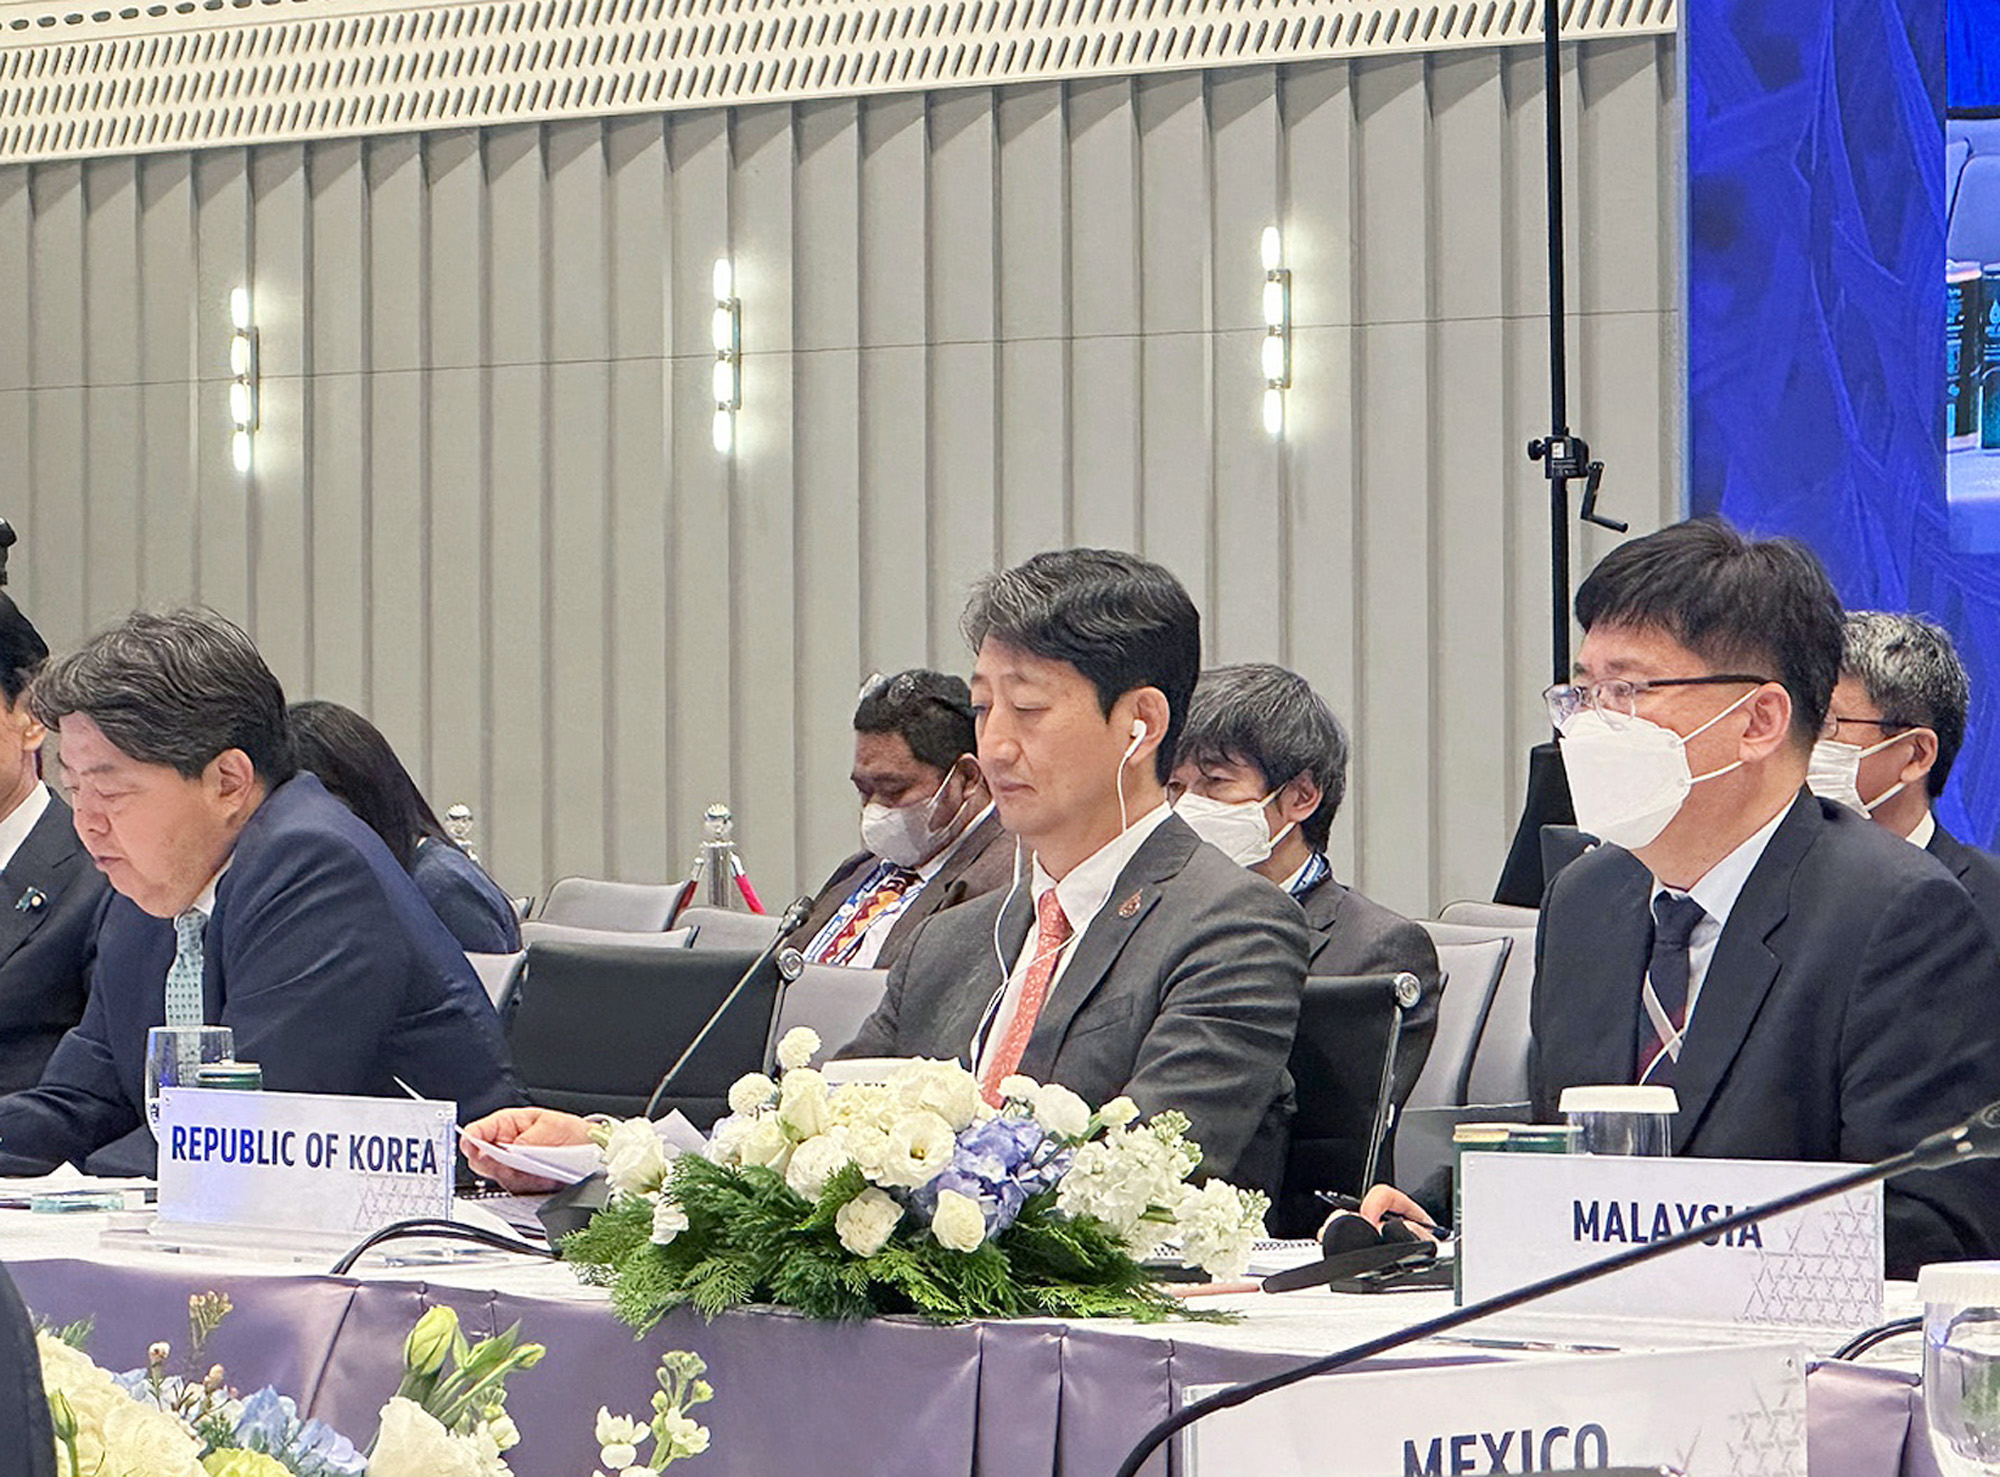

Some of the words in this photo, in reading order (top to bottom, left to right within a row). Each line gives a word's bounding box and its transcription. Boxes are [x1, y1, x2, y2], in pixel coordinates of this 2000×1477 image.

[171, 1125, 296, 1167] REPUBLIC
[305, 1132, 339, 1169] OF
[349, 1135, 438, 1175] KOREA
[1573, 1200, 1762, 1249] MALAYSIA
[1403, 1423, 1610, 1477] MEXICO
